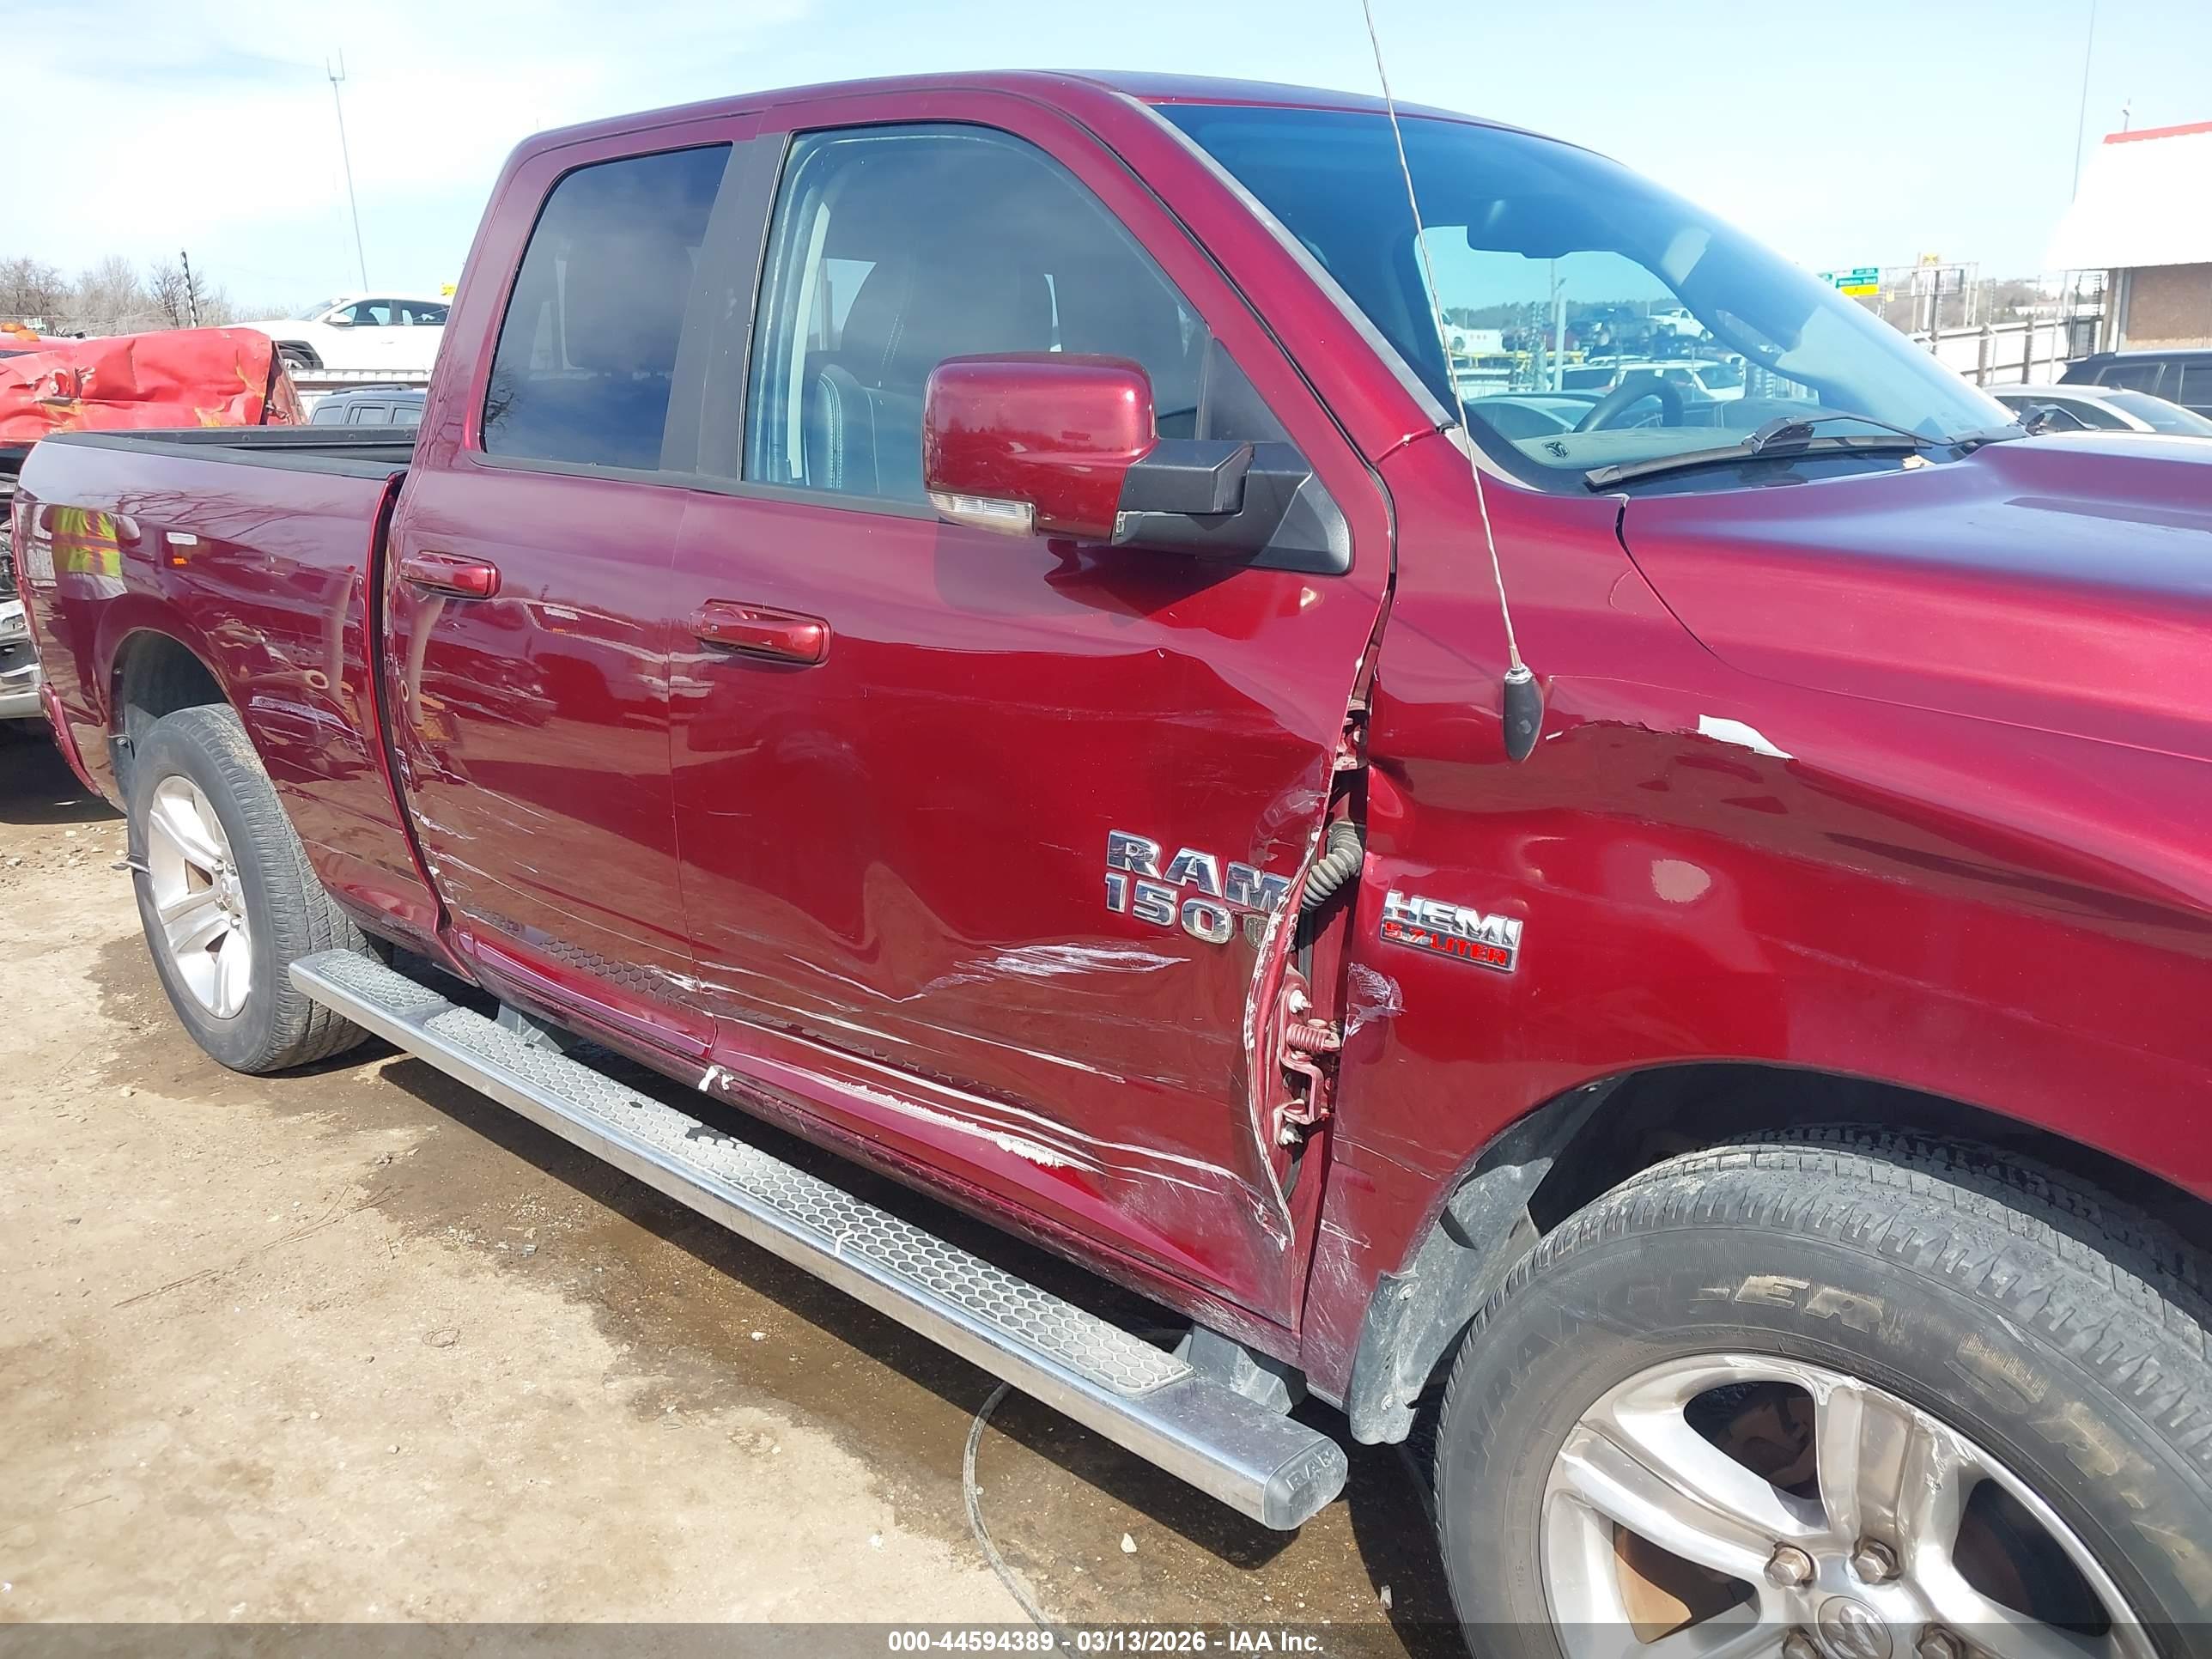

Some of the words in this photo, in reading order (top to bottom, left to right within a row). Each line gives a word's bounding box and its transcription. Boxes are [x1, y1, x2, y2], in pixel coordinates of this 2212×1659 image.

[1107, 830, 1295, 913] RAM
[1383, 889, 1523, 950] HEMI
[1429, 933, 1509, 967] LITER
